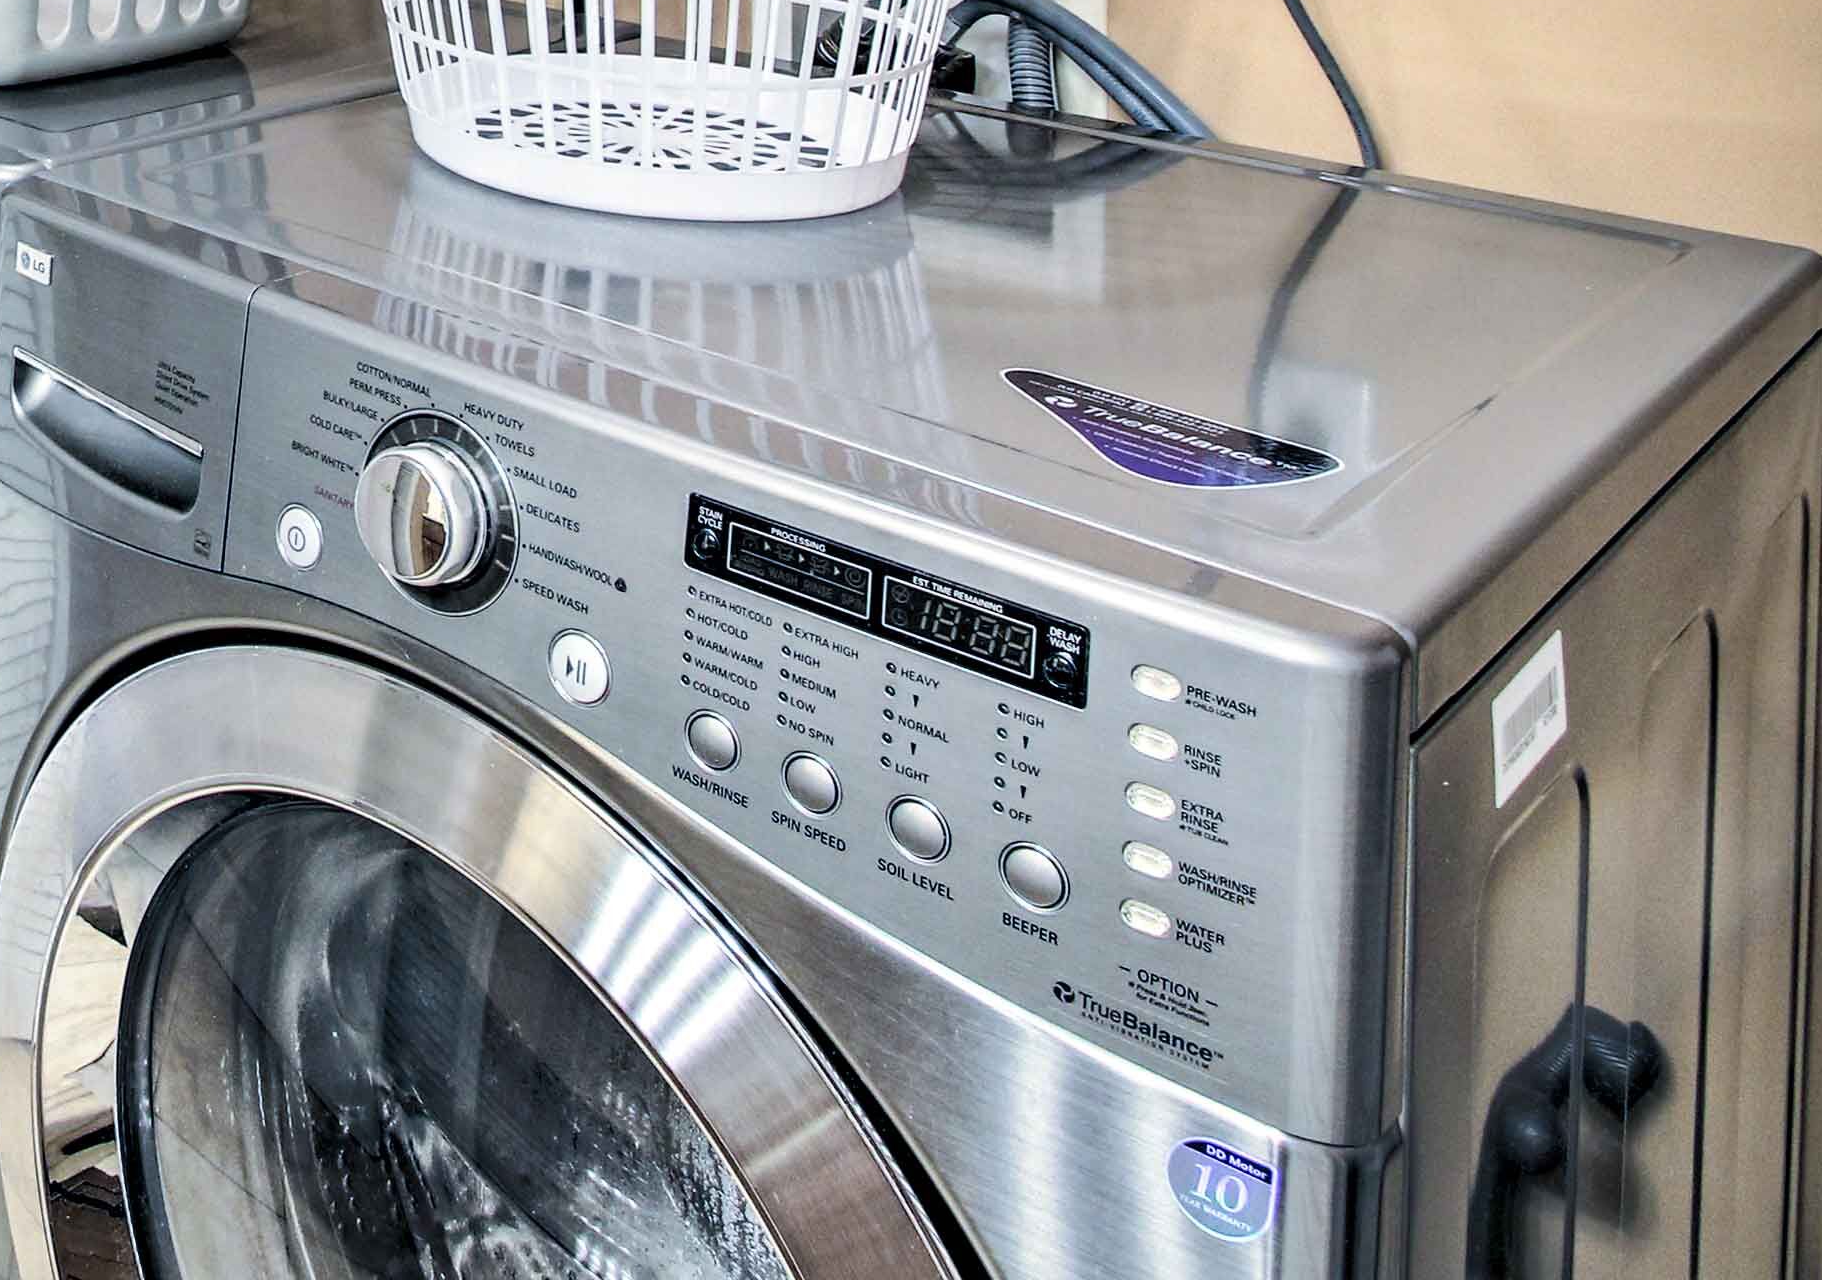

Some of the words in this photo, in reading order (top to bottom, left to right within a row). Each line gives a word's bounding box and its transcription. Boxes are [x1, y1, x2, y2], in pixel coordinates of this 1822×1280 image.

[356, 362, 432, 398] COTTON/NORMAL
[323, 390, 378, 421] BULKY/LARGE
[375, 387, 402, 406] PRESS
[310, 414, 332, 430] COLD
[464, 402, 496, 421] HEAVY
[497, 415, 524, 431] DUTY
[291, 440, 319, 459] BRIGHT
[496, 434, 535, 457] TOWELS
[513, 467, 547, 488] SMALL
[549, 482, 578, 498] LOAD
[526, 503, 581, 533] DELICATES
[697, 515, 723, 531] CYCLE
[699, 506, 723, 521] STAIN
[770, 527, 827, 553] PROCESSING
[529, 543, 612, 587] HANDWASH/WOOL
[522, 578, 555, 600] SPEED
[557, 593, 589, 615] WASH
[699, 591, 727, 609] EXTRA
[728, 603, 773, 627] HOT/COLD
[932, 581, 953, 596] TIME
[953, 589, 1004, 614] REMAINING
[697, 613, 749, 640] HOT/COLD
[1049, 626, 1082, 645] DELAY
[695, 636, 764, 670] WARM/WARM
[794, 627, 829, 649] EXTRA
[832, 641, 859, 660] HIGH
[1049, 639, 1080, 655] WASH
[793, 651, 820, 668] HIGH
[694, 657, 758, 691] WARM/COLD
[791, 673, 837, 700] MEDIUM
[900, 669, 941, 690] HEAVY
[693, 680, 751, 711] COLD/COLD
[790, 696, 817, 714] LOW
[1186, 685, 1257, 718] PRE-WASH
[788, 720, 806, 733] NO
[808, 728, 834, 746] SPIN
[898, 714, 950, 743] NORMAL
[1013, 710, 1045, 729] HIGH
[1011, 759, 1041, 777] LOW
[1184, 744, 1223, 766] RINSE
[672, 764, 750, 808] WASH/RINSE
[895, 763, 931, 784] LIGHT
[1008, 808, 1033, 825] OFF
[1180, 811, 1219, 834] RINSE
[1181, 799, 1224, 822] EXTRA
[771, 810, 801, 834] SPIN
[804, 824, 847, 852] SPEED
[878, 858, 909, 882] SOIL
[912, 872, 955, 902] LEVEL
[1178, 861, 1257, 898] WASH/RINSE
[1002, 912, 1059, 946] BEEPER
[1176, 918, 1226, 946] WATER
[1176, 931, 1213, 953] PLUS
[1137, 969, 1200, 1004] OPTION
[1206, 1144, 1226, 1160] DD
[1229, 1155, 1268, 1180] Motor
[1189, 1162, 1249, 1213] 10
